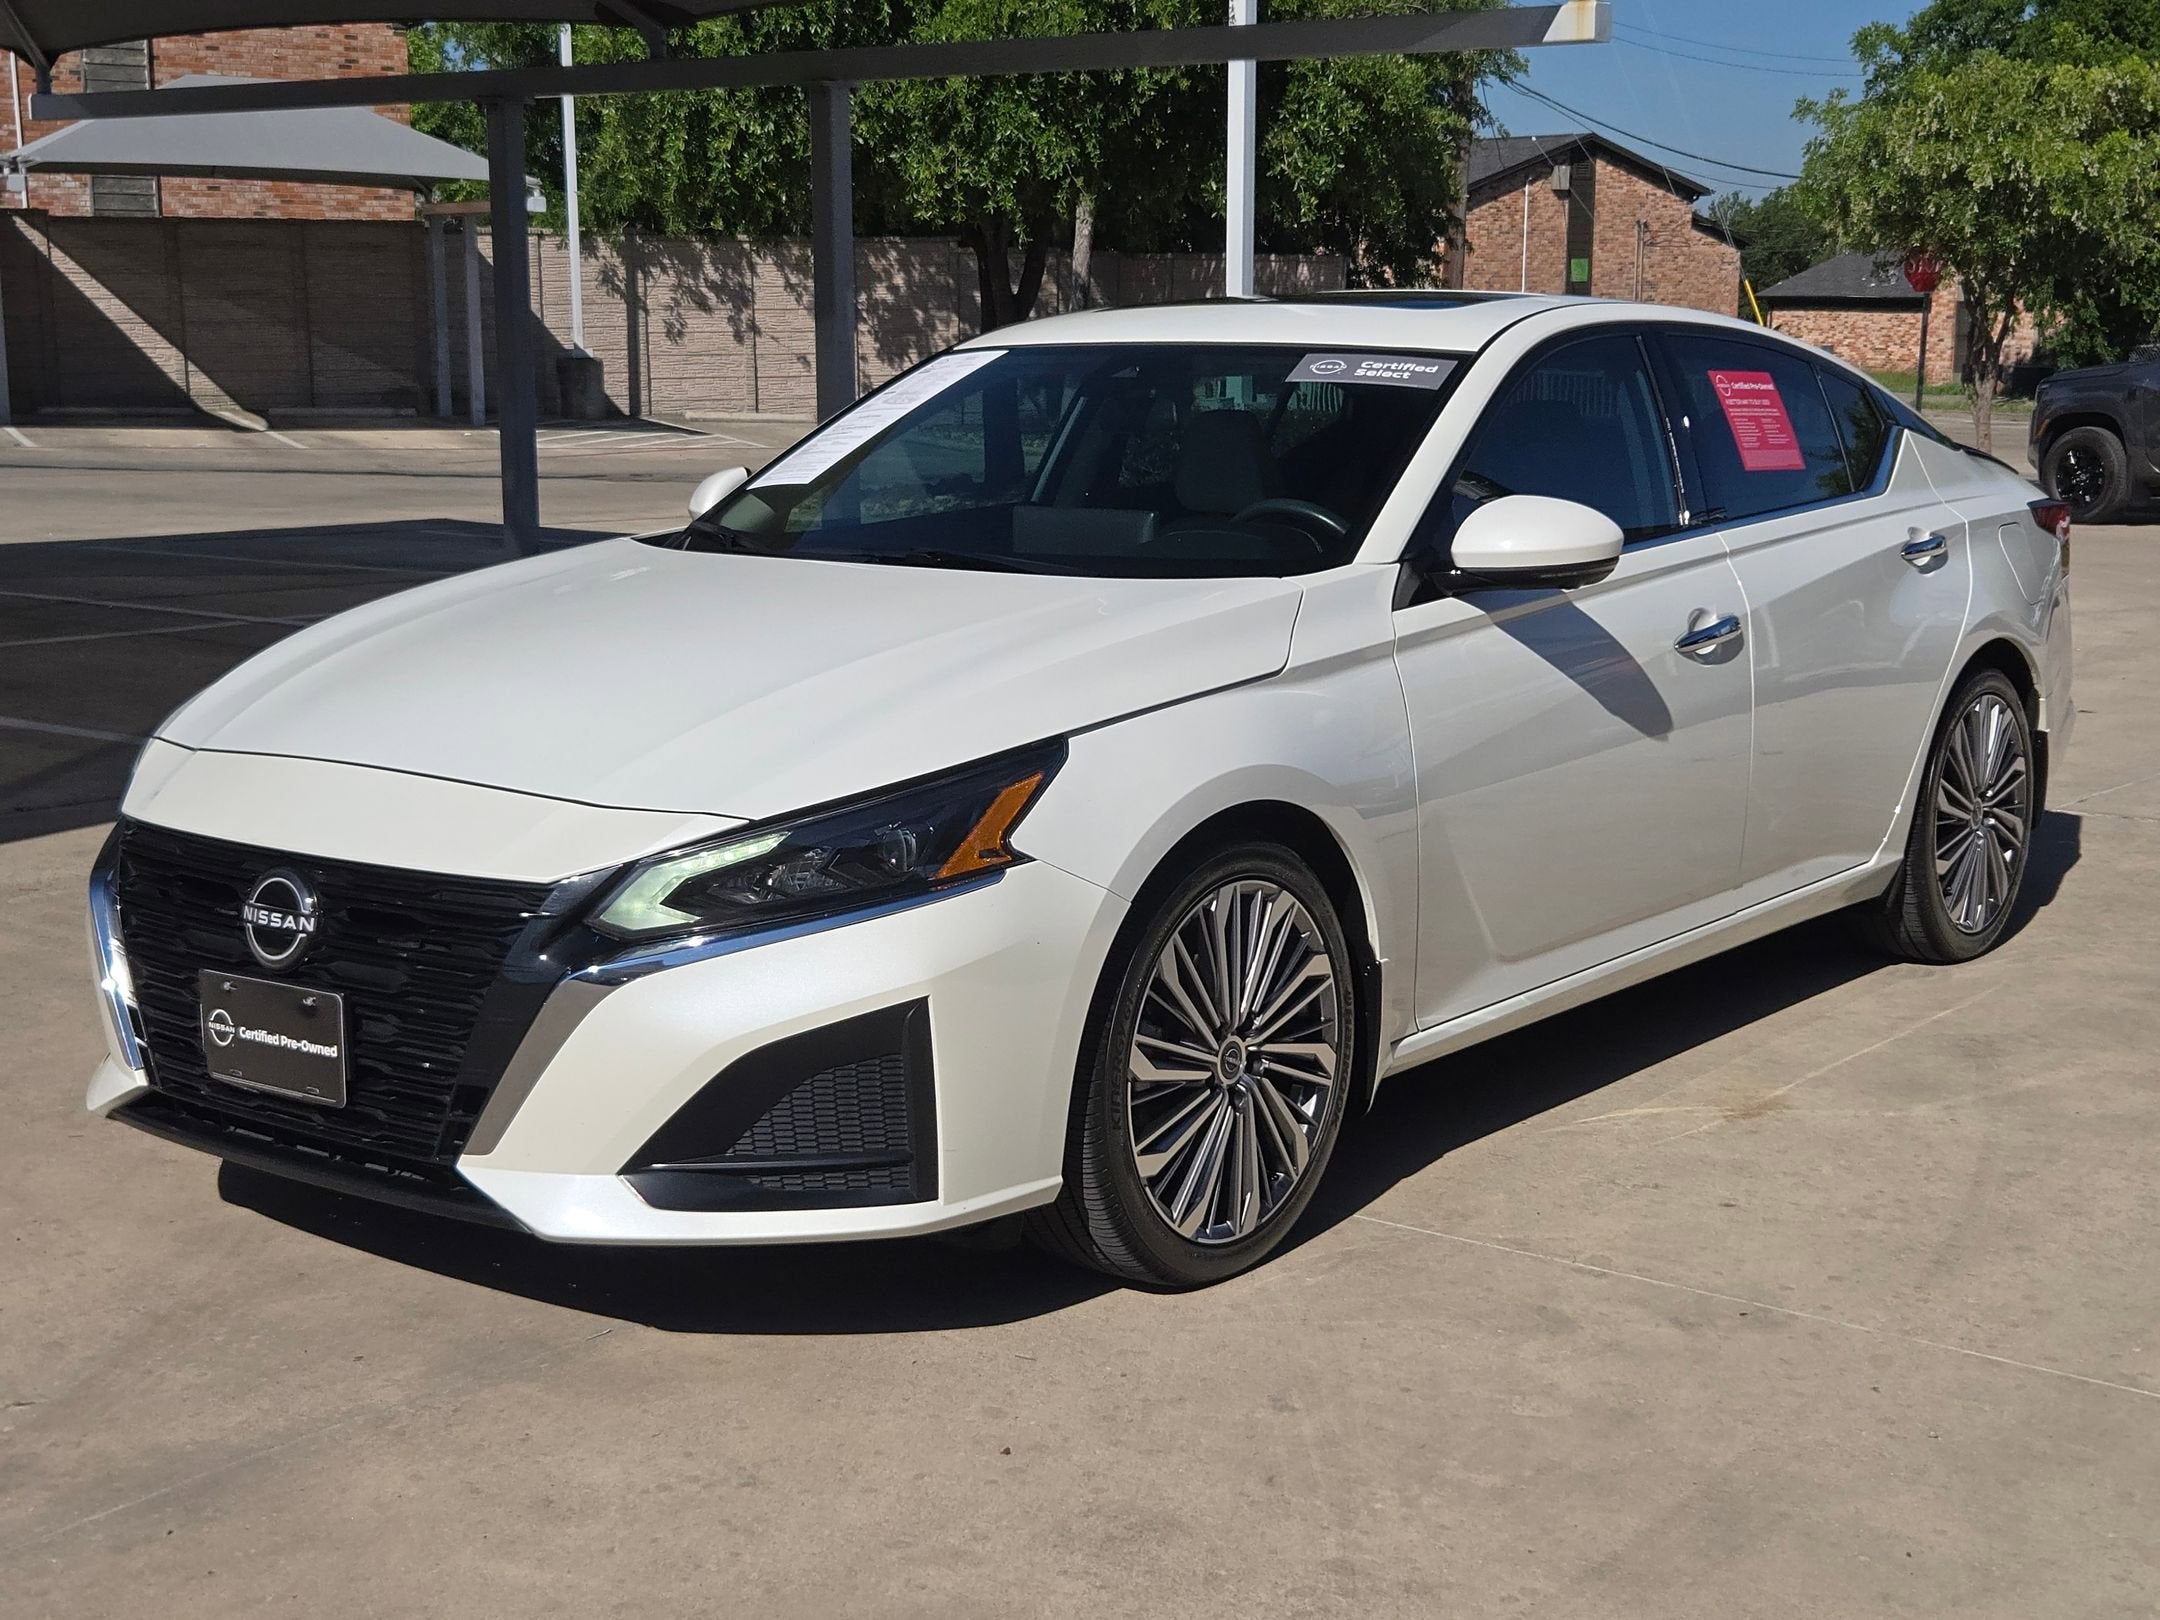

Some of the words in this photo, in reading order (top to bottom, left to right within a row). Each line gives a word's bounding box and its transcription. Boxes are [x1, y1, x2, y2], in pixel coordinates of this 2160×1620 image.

[1354, 368, 1411, 379] Select
[1361, 361, 1439, 374] Certified
[243, 905, 315, 932] NISSAN
[208, 1021, 235, 1033] NISSAN
[239, 1027, 279, 1045] Certified
[281, 1035, 338, 1057] Pre-Owned
